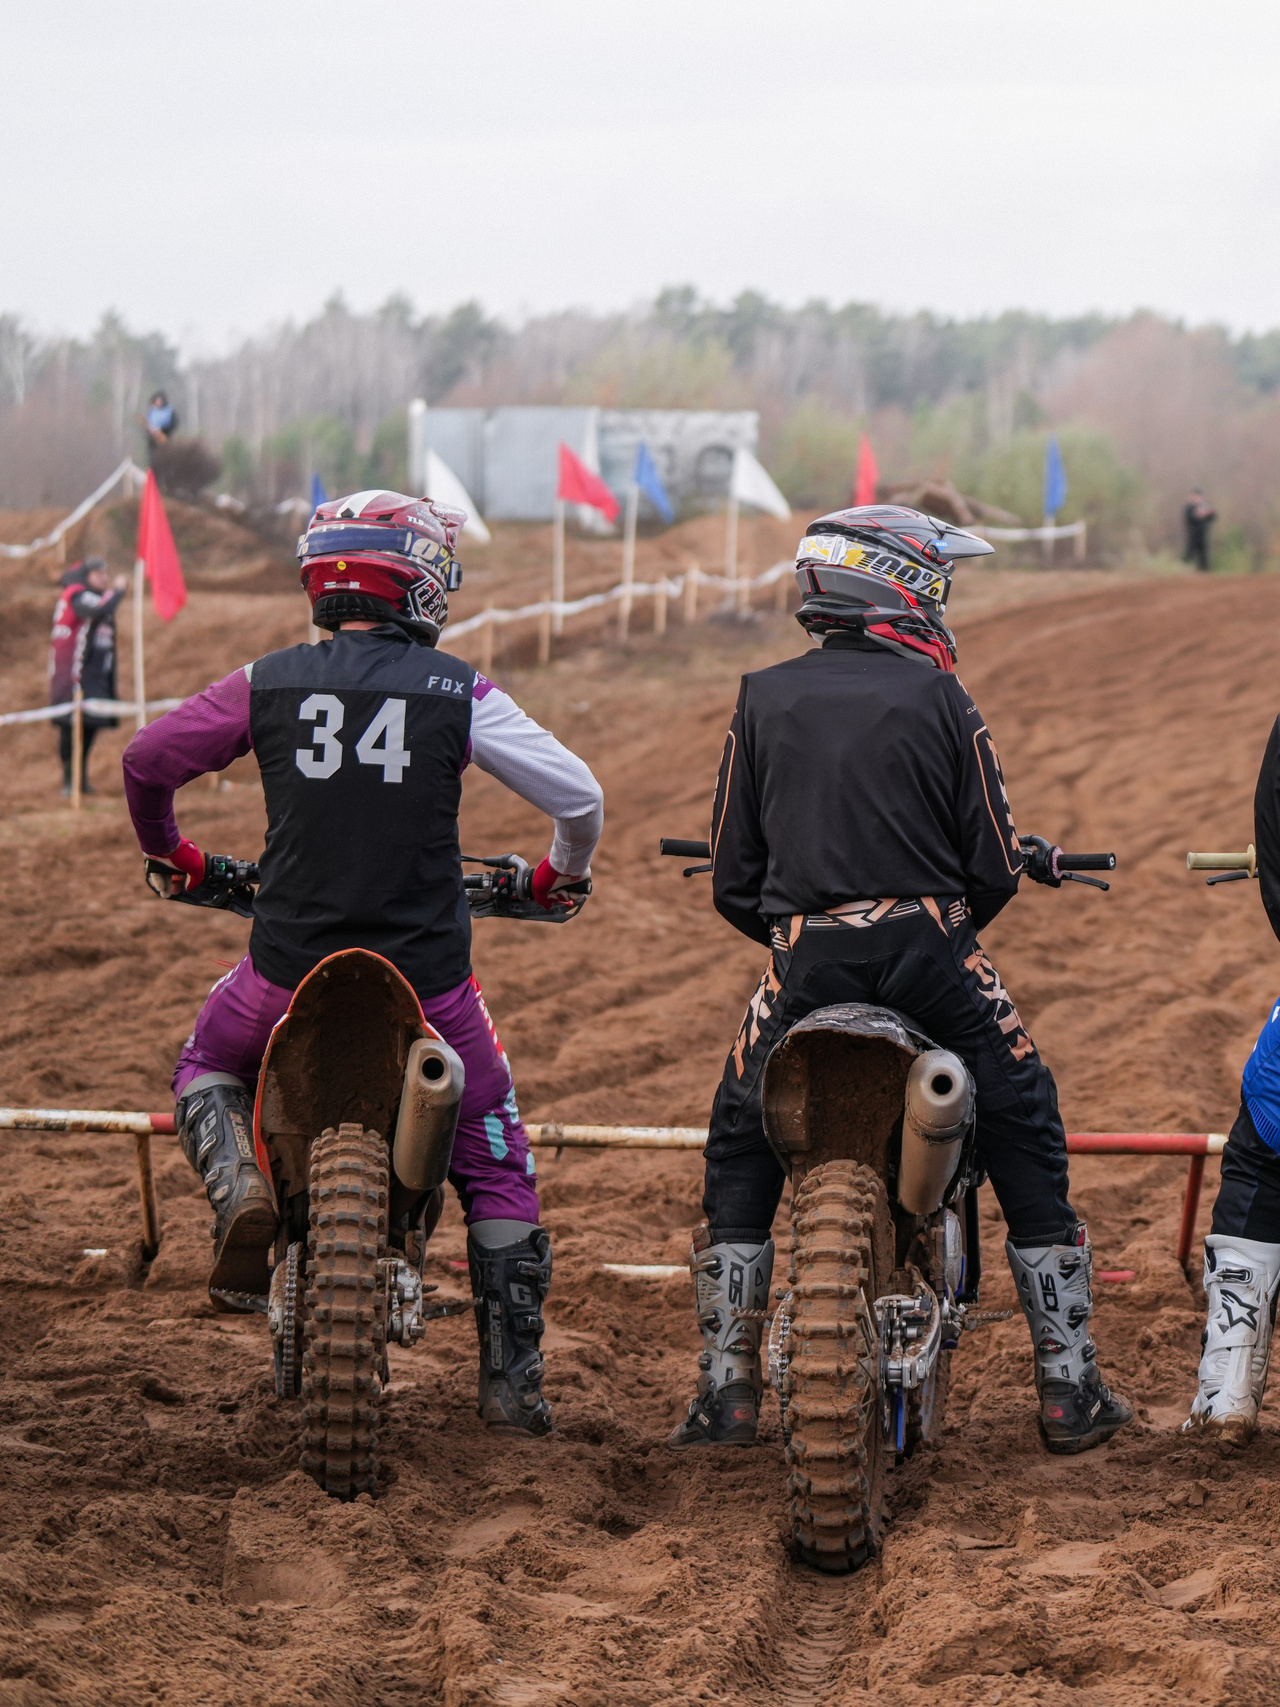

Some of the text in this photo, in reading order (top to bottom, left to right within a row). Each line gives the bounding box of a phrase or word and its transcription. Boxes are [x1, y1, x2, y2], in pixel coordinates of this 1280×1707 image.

[856, 550, 942, 597] 100%
[427, 675, 466, 695] FOX
[295, 692, 411, 784] 34
